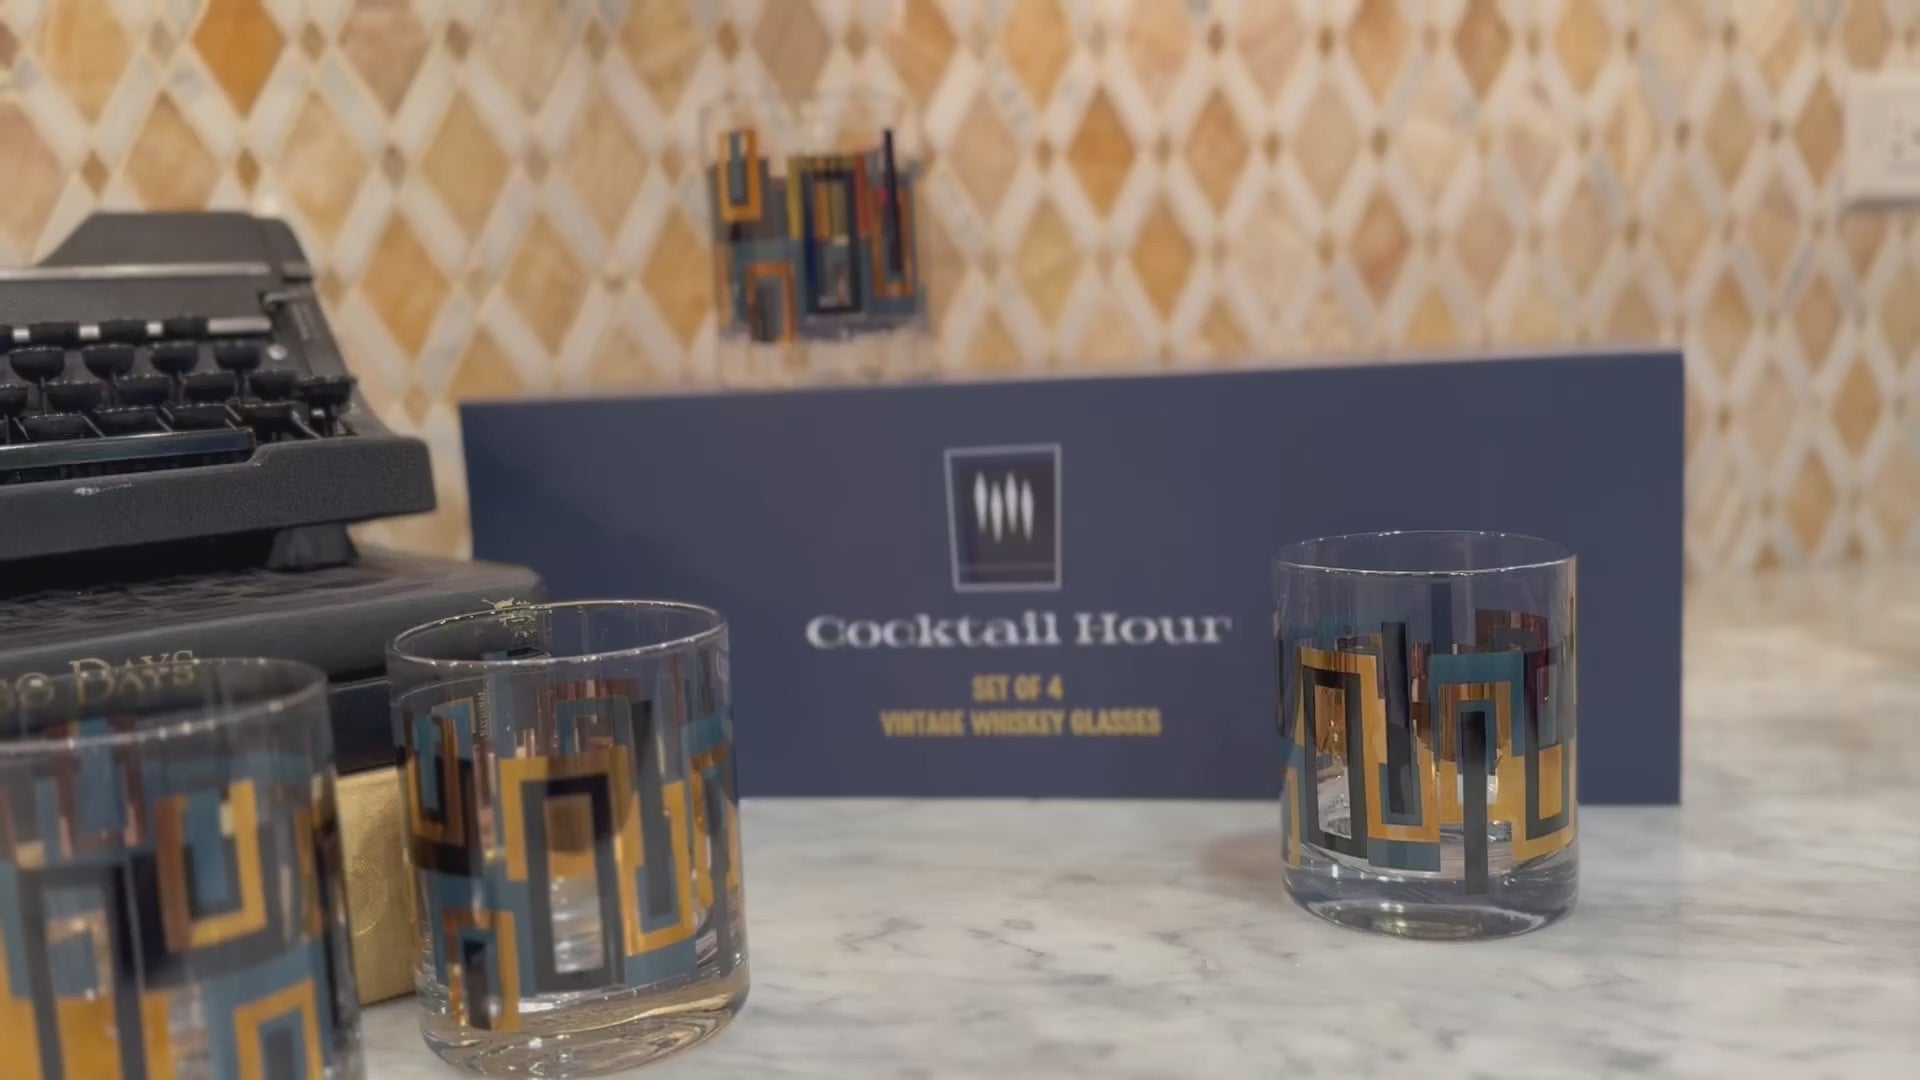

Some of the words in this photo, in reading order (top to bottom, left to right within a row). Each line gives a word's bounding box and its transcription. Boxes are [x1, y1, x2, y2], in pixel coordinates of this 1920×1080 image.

[805, 609, 1062, 648] Cocktail
[1073, 611, 1232, 645] Hour
[971, 675, 1009, 701] SET
[1013, 674, 1041, 700] OF
[1046, 674, 1064, 700] 4
[880, 710, 965, 736] VINTAGE
[972, 709, 1064, 736] WHISKEY
[1070, 708, 1162, 736] GLASSES
